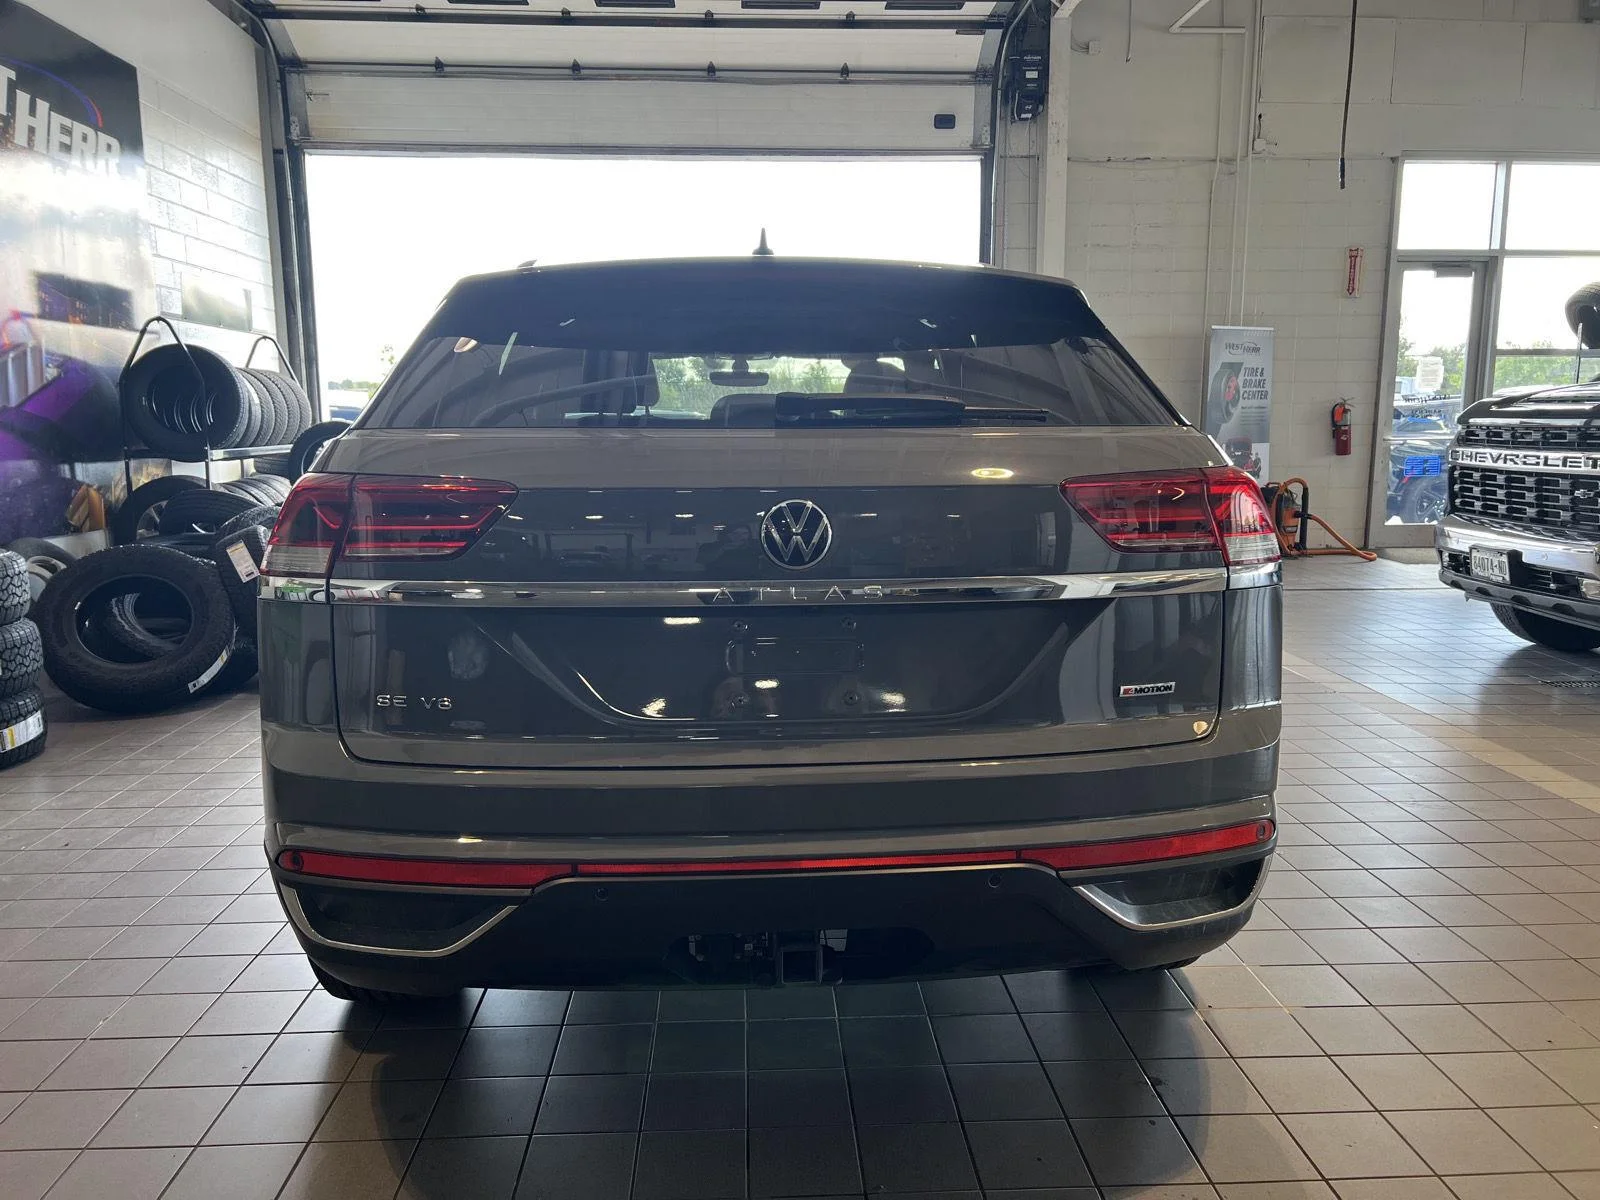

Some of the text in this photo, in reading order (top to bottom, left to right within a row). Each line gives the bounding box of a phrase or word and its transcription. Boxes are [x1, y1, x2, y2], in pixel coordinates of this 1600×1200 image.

[1243, 367, 1265, 378] TIRE &
[1242, 378, 1266, 389] BRAKE
[1242, 390, 1269, 400] CENTER
[1450, 449, 1600, 470] CHEVROLET
[712, 585, 884, 603] ATLAS
[376, 694, 408, 707] SE
